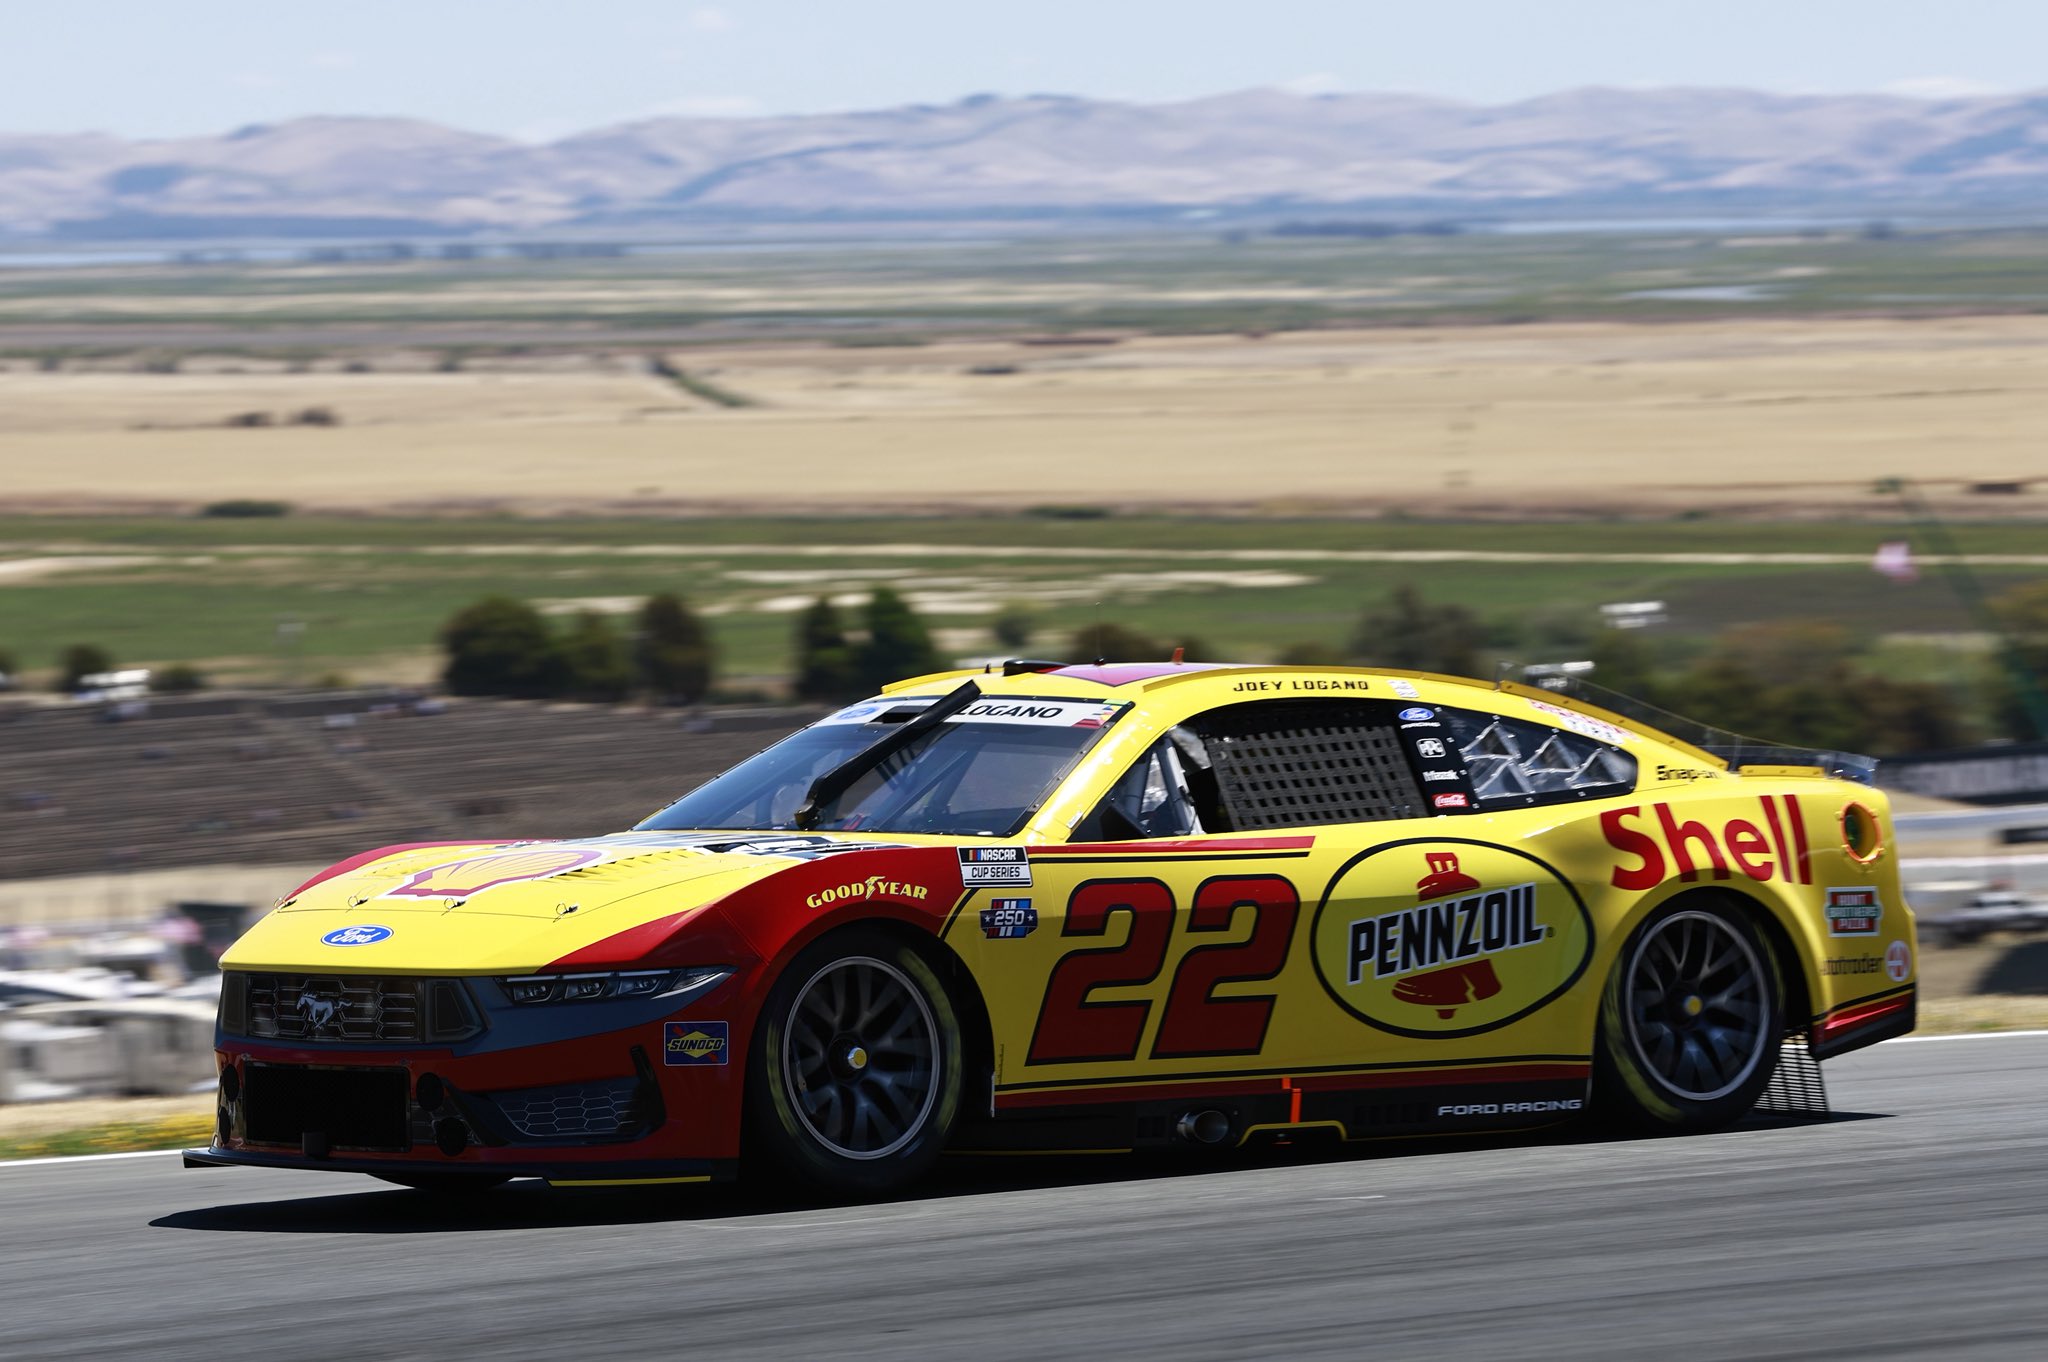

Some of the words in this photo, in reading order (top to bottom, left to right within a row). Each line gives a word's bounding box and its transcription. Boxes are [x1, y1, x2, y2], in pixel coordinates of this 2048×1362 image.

[1233, 680, 1283, 692] JOEY
[1292, 680, 1370, 691] LOGANO
[957, 703, 1064, 719] LOGANO
[1656, 765, 1719, 783] Snap-on
[1599, 793, 1813, 891] Shell
[980, 848, 1017, 861] NASCAR
[971, 867, 990, 879] CUP
[990, 866, 1021, 878] SERIES
[993, 910, 1025, 926] 250
[328, 926, 384, 943] Ford
[1347, 882, 1547, 985] PENNZOIL
[1024, 873, 1301, 1067] 22
[669, 1038, 724, 1051] SUNOCO
[1438, 1103, 1499, 1116] FORD
[1502, 1099, 1582, 1113] RACING
